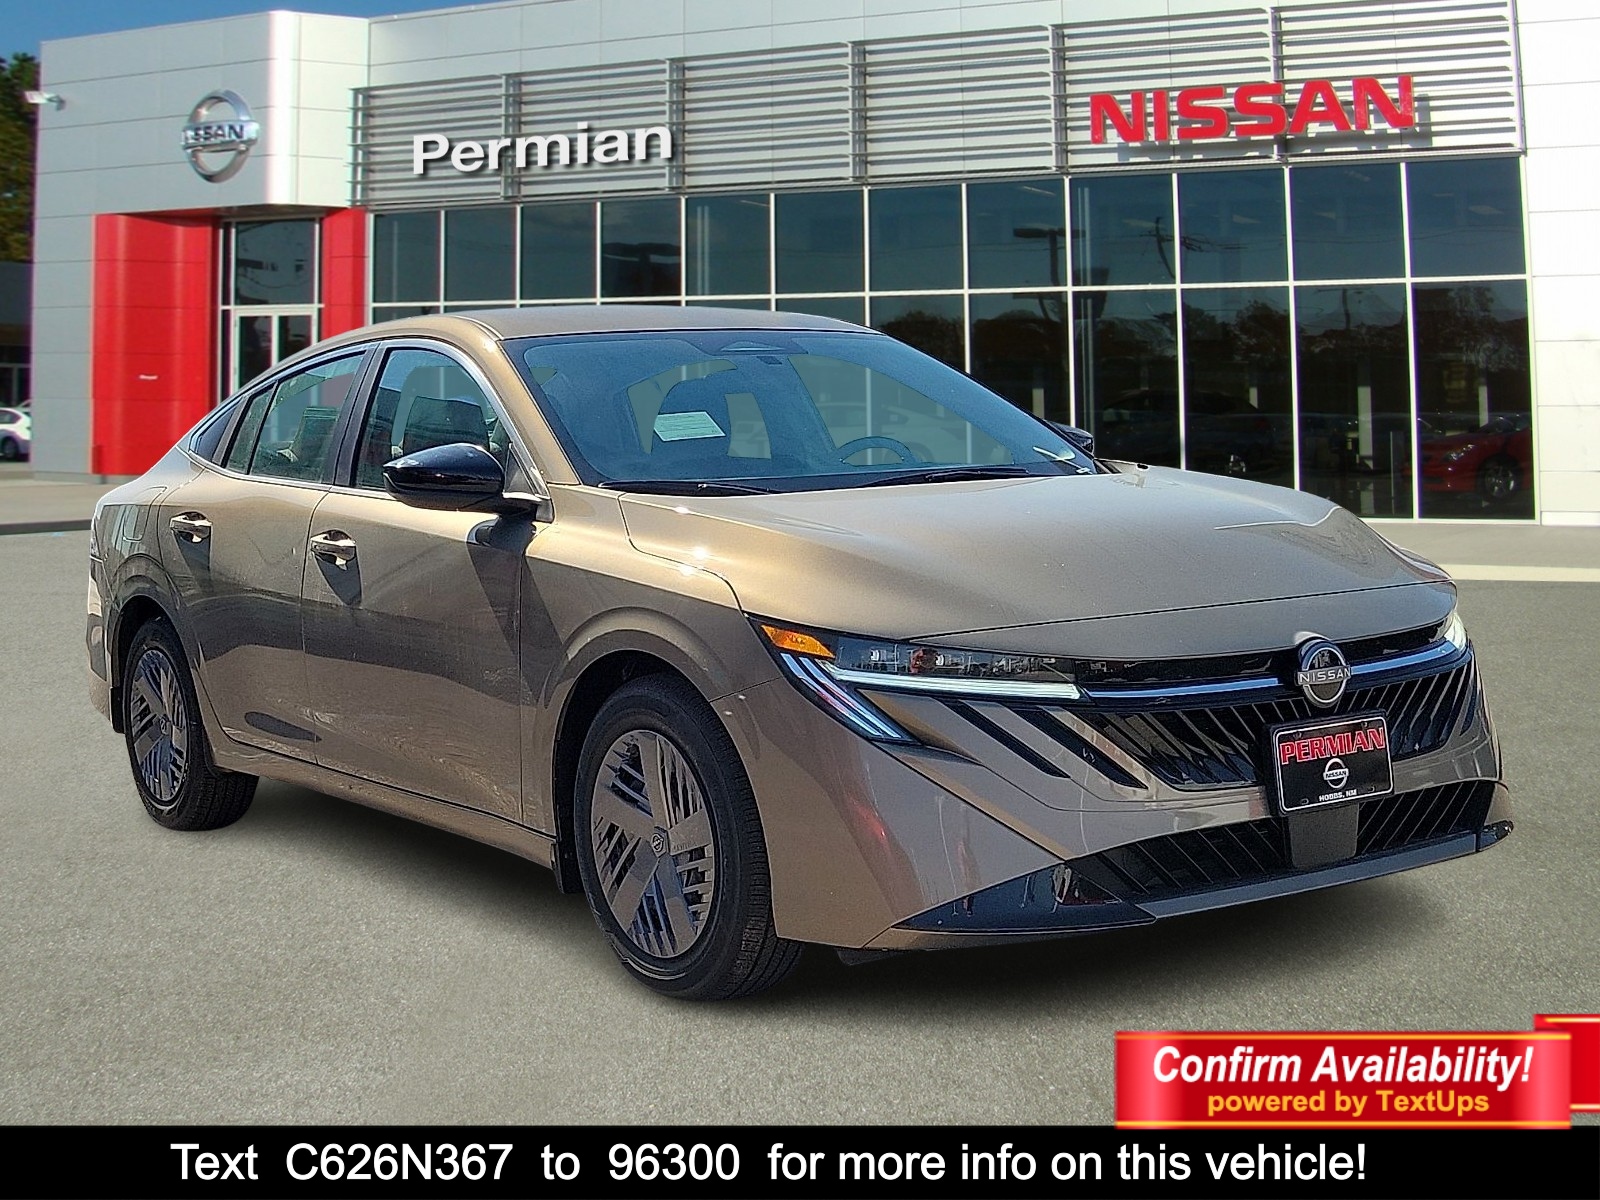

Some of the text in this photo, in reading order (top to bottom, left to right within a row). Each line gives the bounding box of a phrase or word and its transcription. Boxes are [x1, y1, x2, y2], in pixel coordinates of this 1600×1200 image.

[1089, 74, 1416, 144] NISSAN
[413, 121, 673, 175] Permian
[1299, 667, 1351, 684] NISSAN
[1279, 727, 1386, 766] PERMIAN
